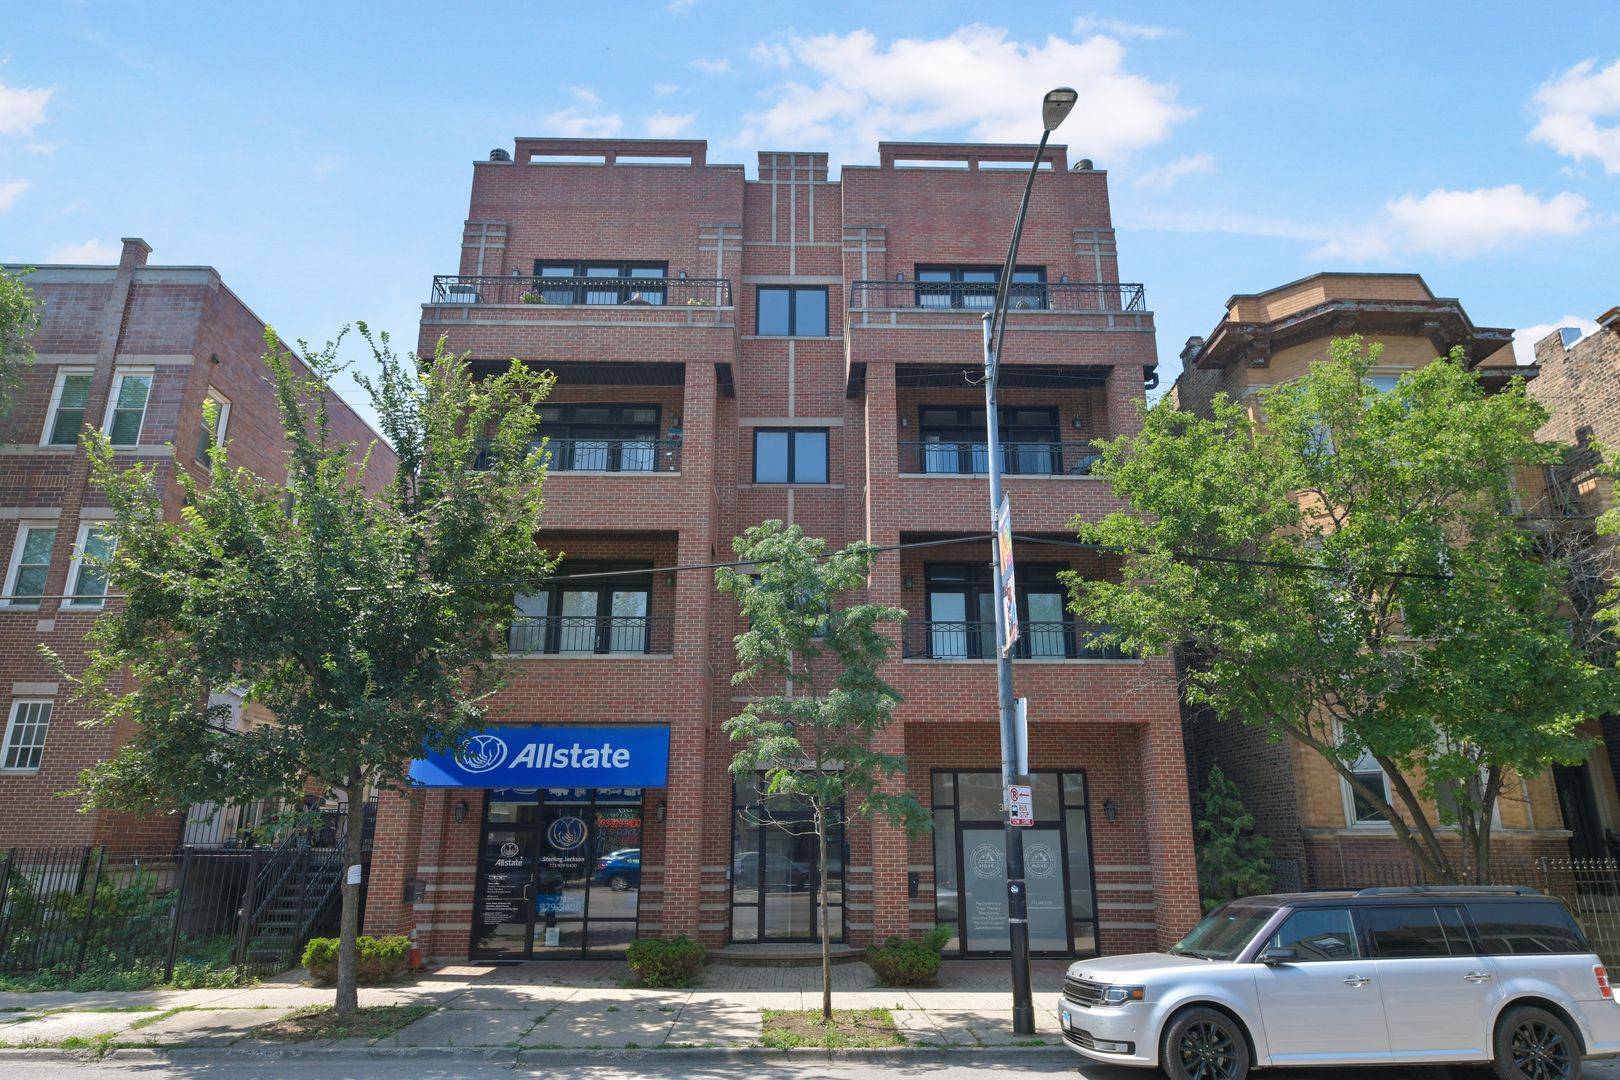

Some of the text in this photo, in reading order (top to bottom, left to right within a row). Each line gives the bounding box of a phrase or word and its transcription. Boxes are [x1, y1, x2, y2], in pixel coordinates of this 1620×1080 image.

[508, 743, 630, 769] Allstate
[598, 818, 642, 828] 773-929-9400
[494, 859, 522, 867] Allstate
[540, 903, 582, 912] 929-9400
